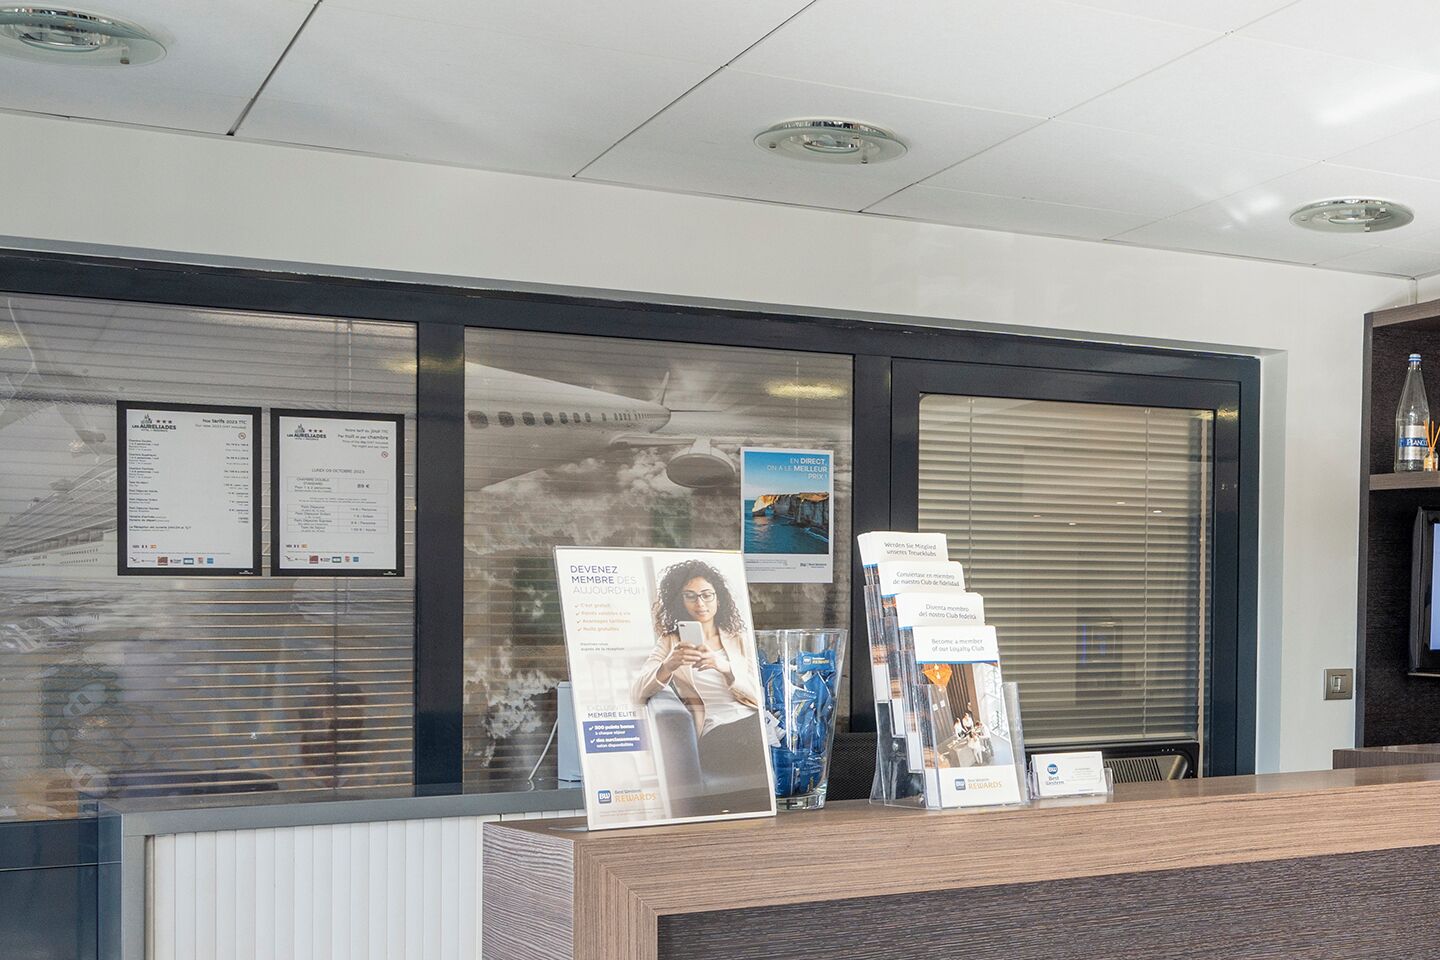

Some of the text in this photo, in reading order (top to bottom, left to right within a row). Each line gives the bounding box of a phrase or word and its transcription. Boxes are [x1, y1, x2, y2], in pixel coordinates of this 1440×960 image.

[915, 543, 936, 551] Mitglied
[570, 565, 618, 574] DEVENEZ
[572, 576, 615, 584] MEMBRE
[573, 586, 641, 595] AUJOURD'HUI
[968, 781, 1002, 790] REWARDS
[615, 792, 657, 802] REWARDS
